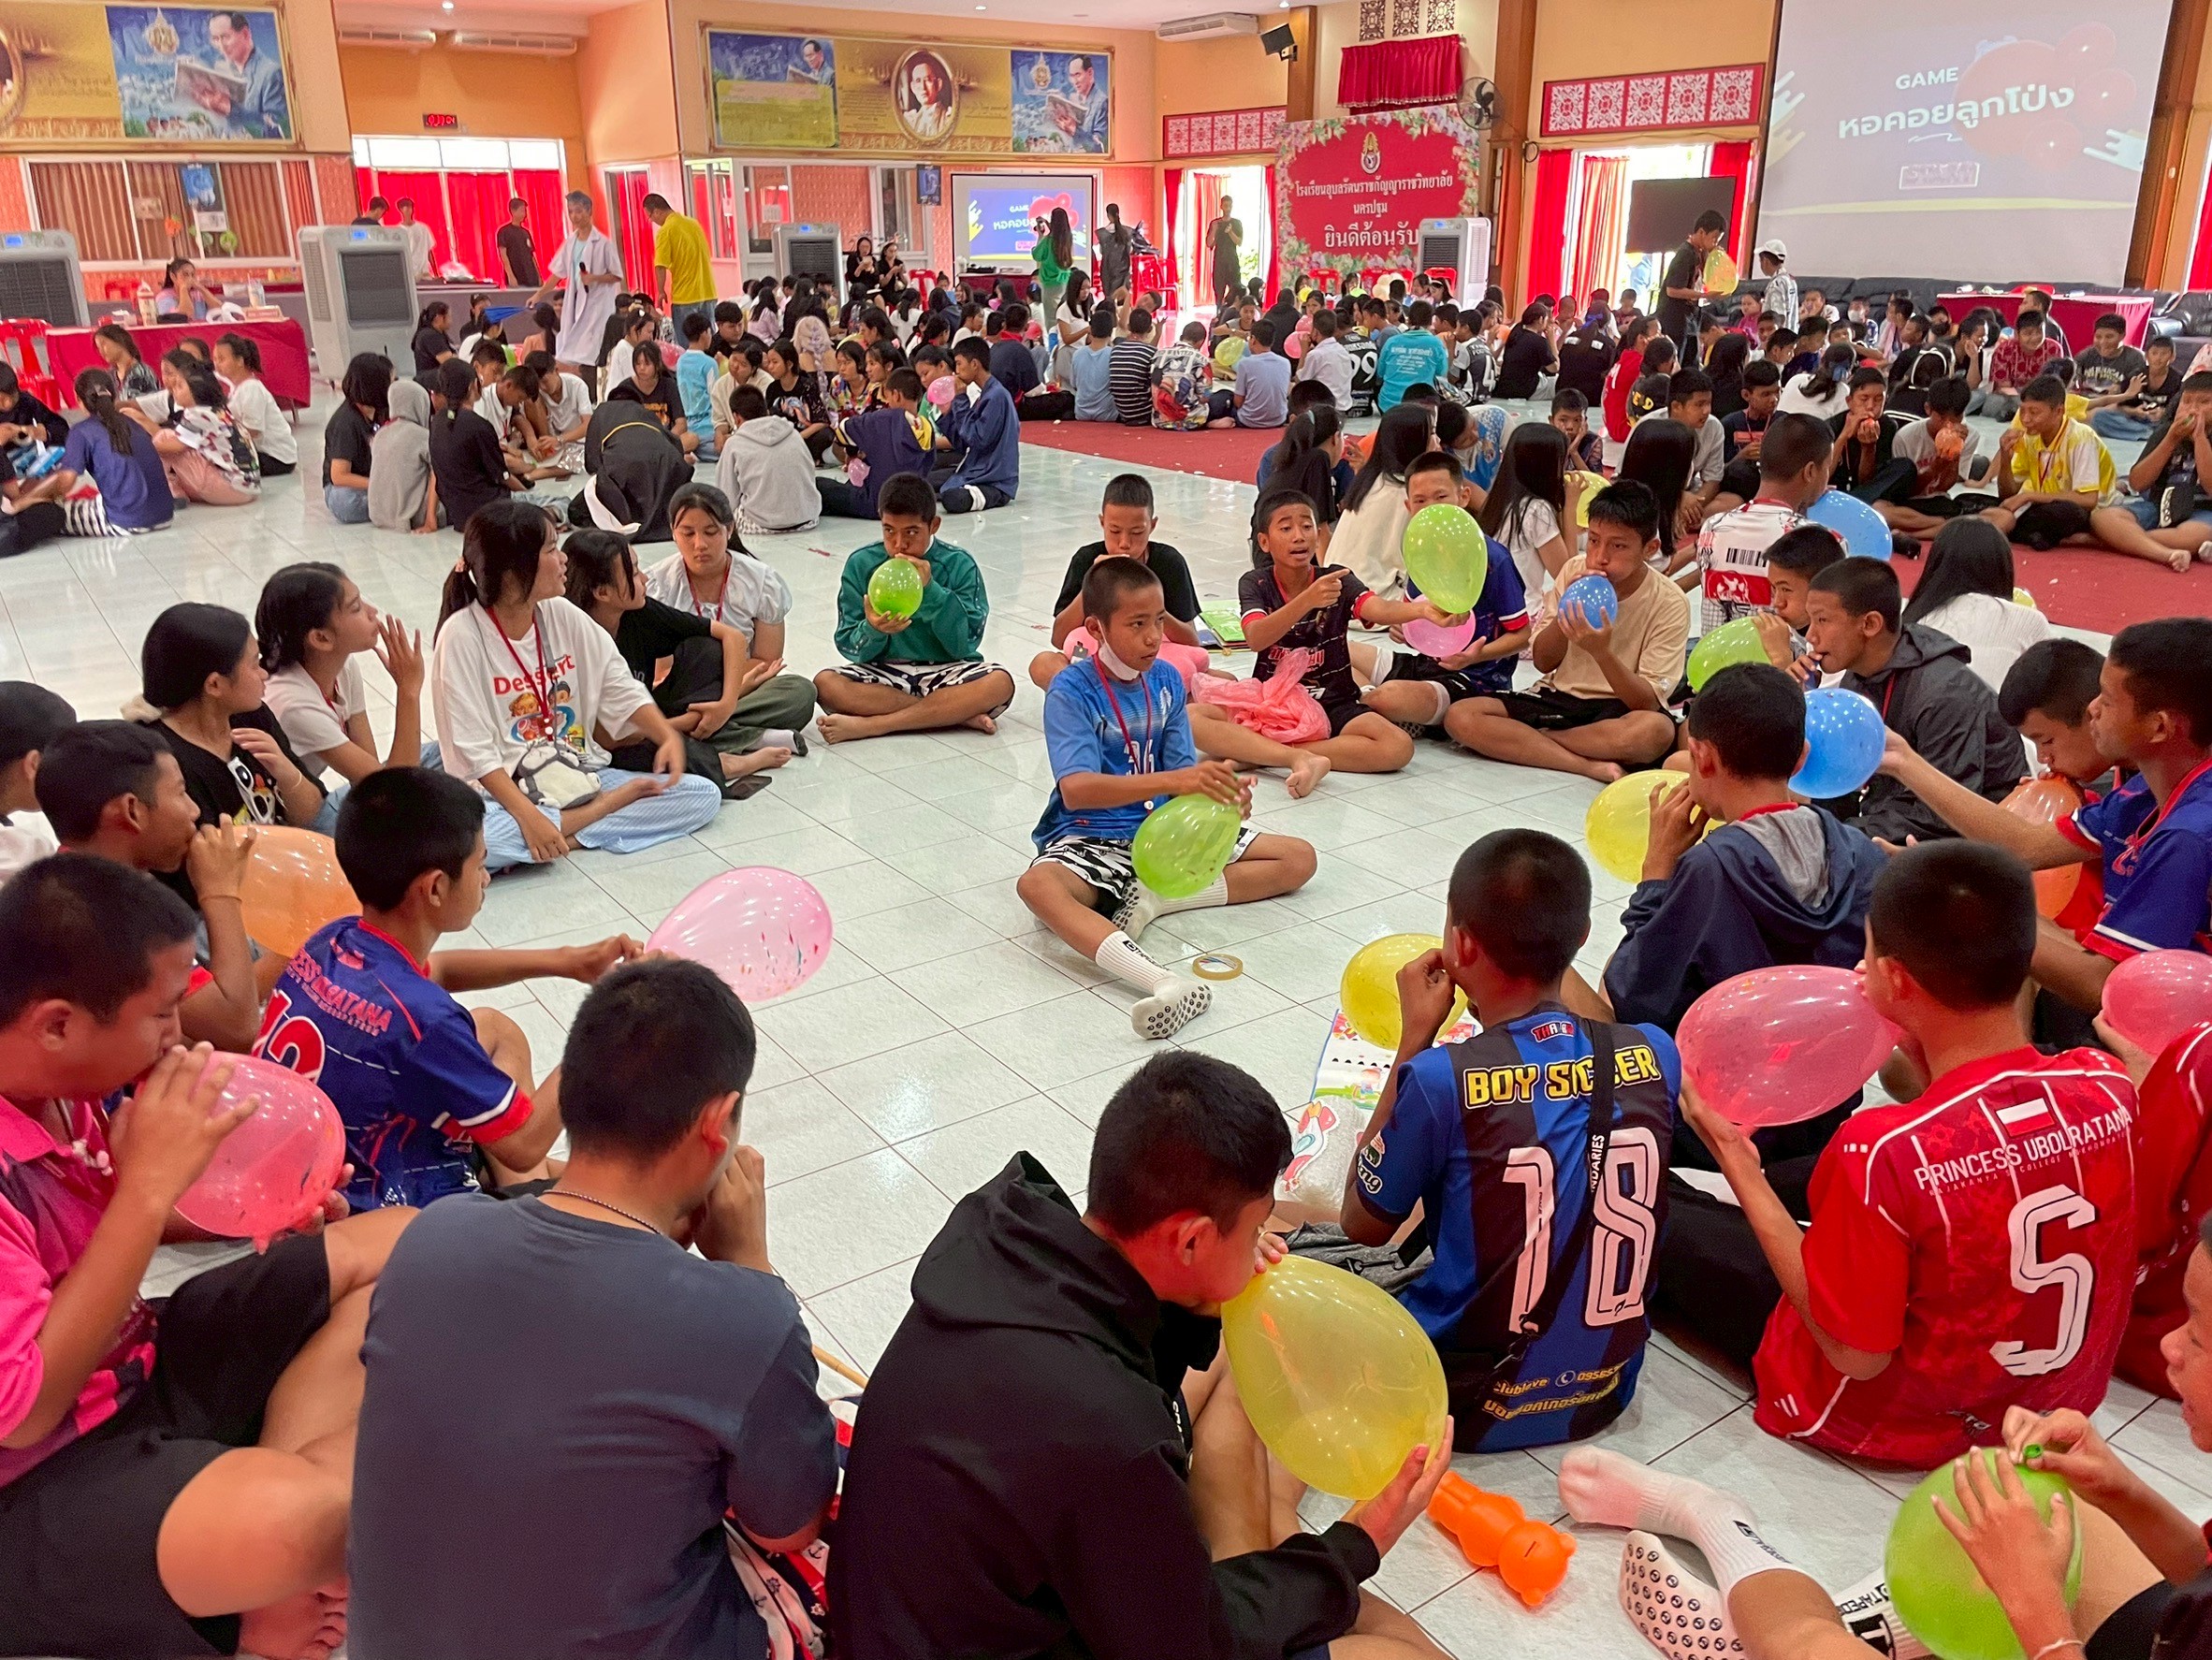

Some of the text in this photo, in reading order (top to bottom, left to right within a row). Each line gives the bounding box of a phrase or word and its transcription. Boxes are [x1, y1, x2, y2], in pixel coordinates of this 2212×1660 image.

[1895, 67, 1959, 90] GAME
[1838, 82, 2075, 138] หอคอยลูกโป่ง
[993, 216, 1037, 231] หอคอย
[1324, 221, 1419, 248] ยินดีต้อนรับ
[1353, 200, 1389, 218] นครปฐม
[1466, 1046, 1661, 1107] BOY SCER
[1591, 1134, 1606, 1193] NDARIES
[1913, 1105, 2133, 1190] PRINCESS UBOLRATANA
[2019, 1158, 2061, 1174] COLLEGE
[1502, 1127, 1660, 1333] 18
[1989, 1184, 2097, 1376] 5
